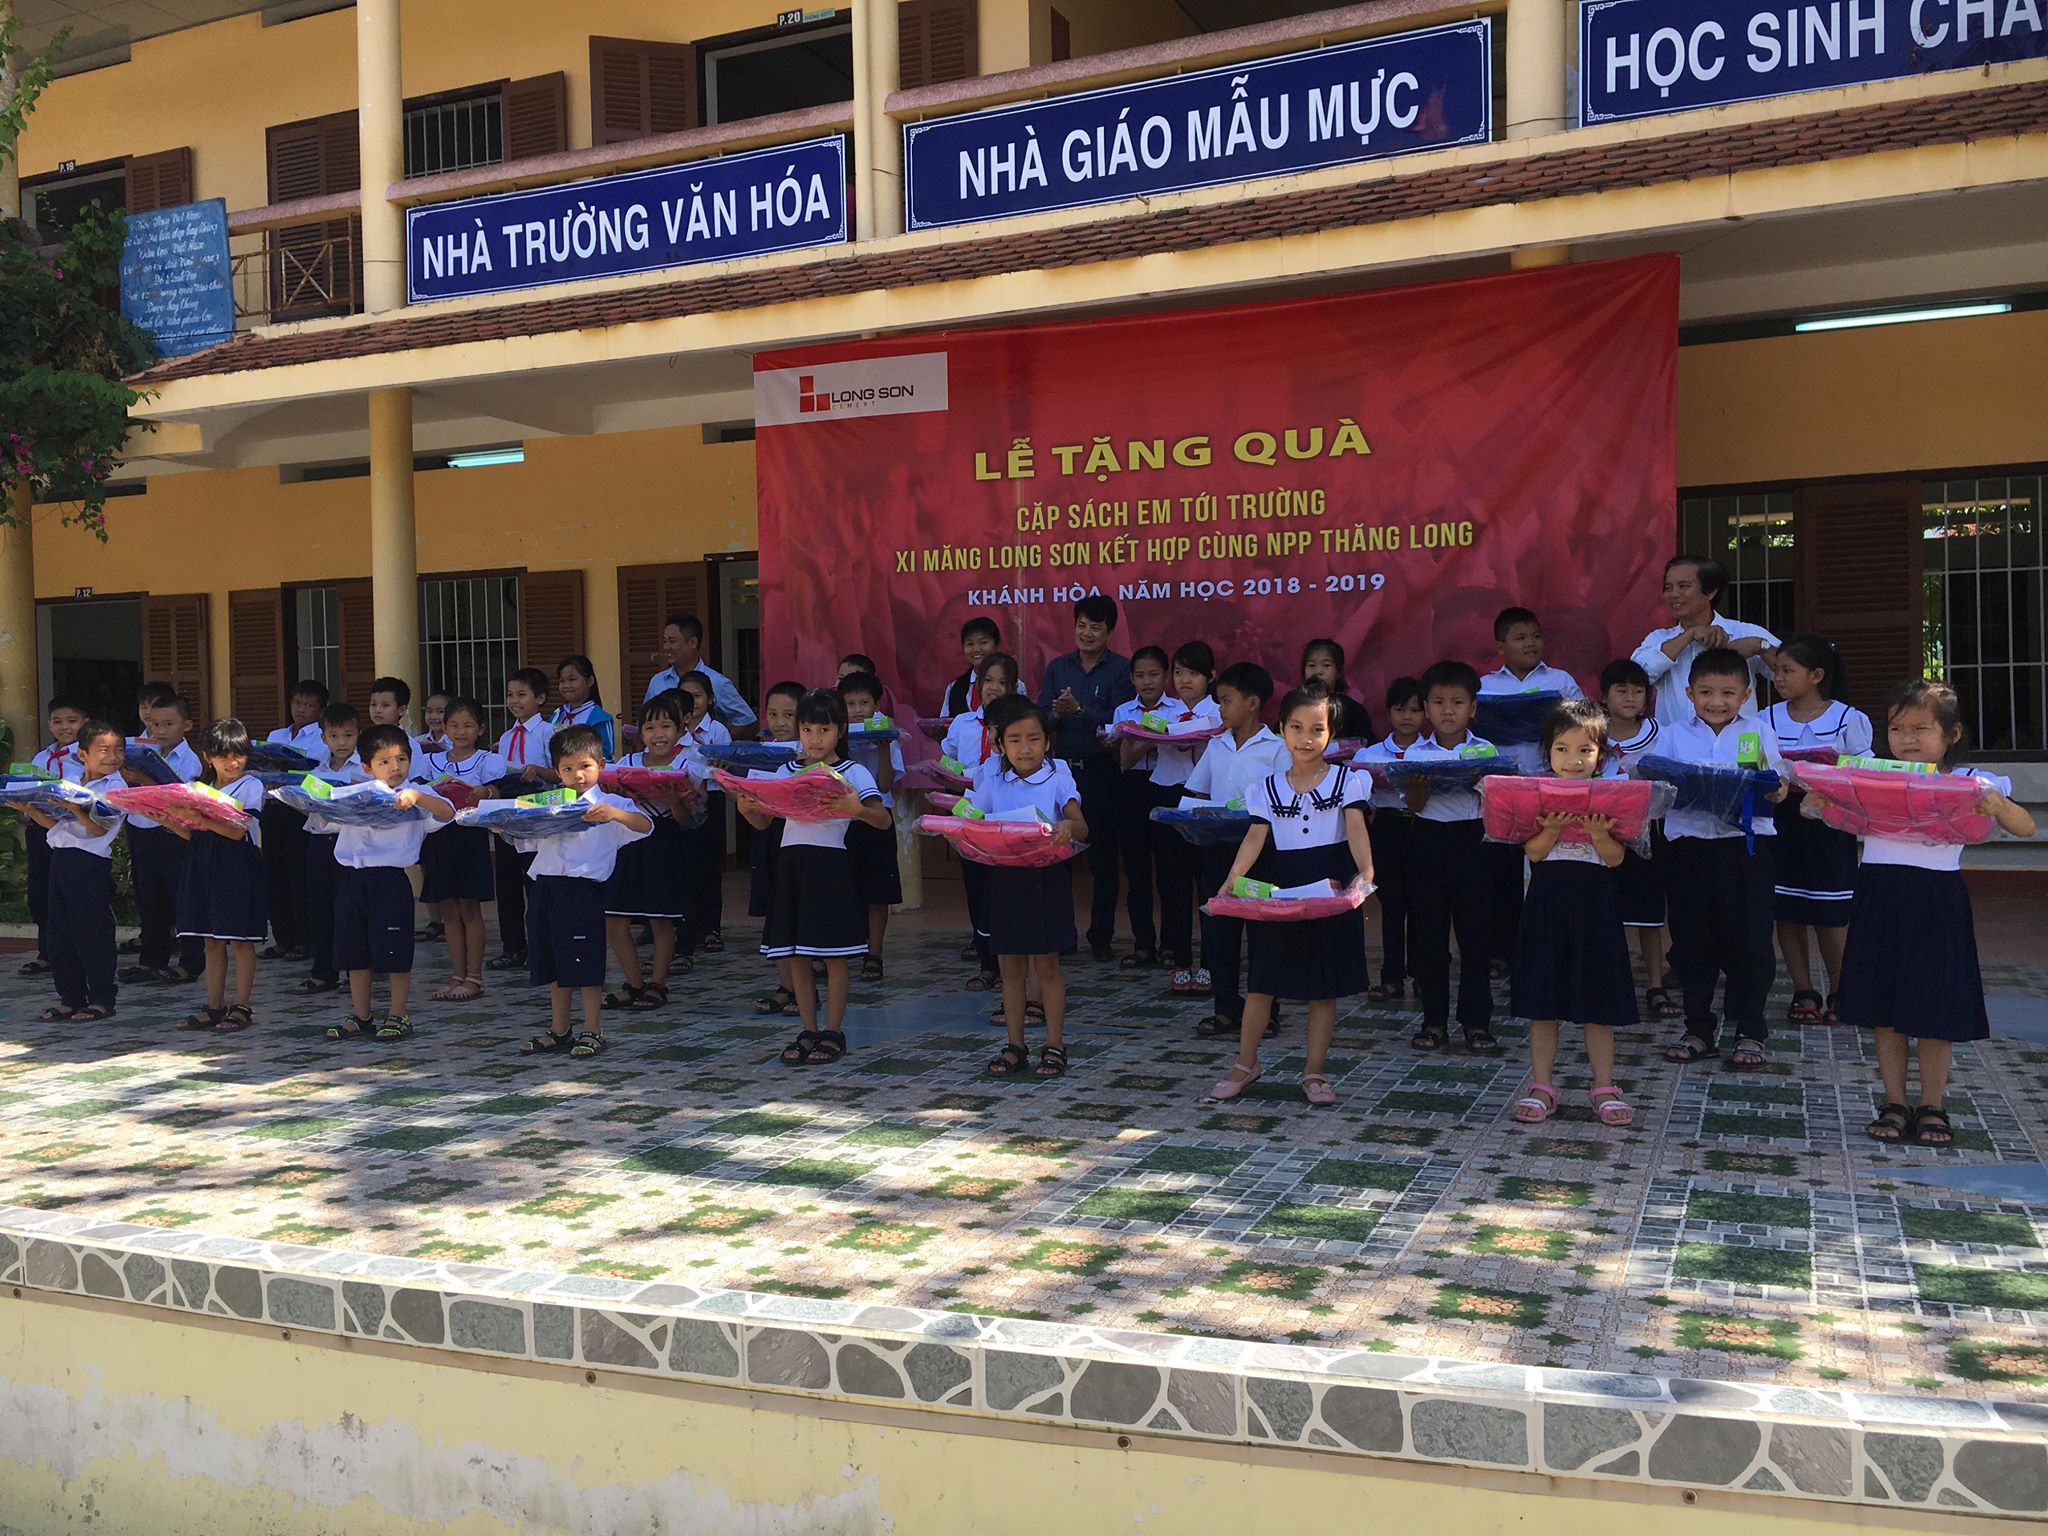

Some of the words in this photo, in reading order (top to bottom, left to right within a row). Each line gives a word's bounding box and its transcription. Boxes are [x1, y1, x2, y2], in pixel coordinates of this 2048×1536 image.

[779, 11, 801, 26] P.20
[1605, 21, 1726, 98] HỌC
[1746, 0, 1886, 73] SINH
[958, 125, 1048, 200] NHÀ
[1061, 107, 1172, 183] GIÁO
[1187, 74, 1291, 162] MẪU
[1308, 68, 1420, 146] MỰC
[422, 218, 493, 280] NHÀ
[502, 201, 650, 269] TRƯỜNG
[661, 182, 739, 245] VĂN
[750, 164, 831, 233] HÓA
[831, 388, 875, 403] LONG
[878, 385, 914, 399] SON
[975, 436, 1035, 481] LỄ
[1052, 434, 1212, 482] TẶNG
[1233, 418, 1372, 466] QUÀ
[1016, 501, 1061, 535] CẶP
[1068, 499, 1128, 529] SÁCH
[1138, 499, 1171, 525] EM
[1180, 493, 1218, 523] TỚI
[1226, 487, 1326, 520] TRƯỜNG
[896, 551, 916, 573] XI
[923, 544, 982, 572] MĂNG
[989, 544, 1042, 569] LONG
[1049, 541, 1091, 567] SƠN
[1099, 533, 1139, 564] KẾT
[1147, 537, 1191, 566] HỢP
[1198, 531, 1259, 560] CÙNG
[1267, 531, 1312, 556] NPP
[1320, 523, 1401, 553] THĂNG
[1409, 521, 1474, 549] LONG
[968, 584, 1045, 606] KHÁNH
[1118, 580, 1171, 601] NĂM
[1180, 580, 1235, 602] HỌC
[1243, 577, 1301, 596] 2018
[1325, 573, 1386, 593] 2019
